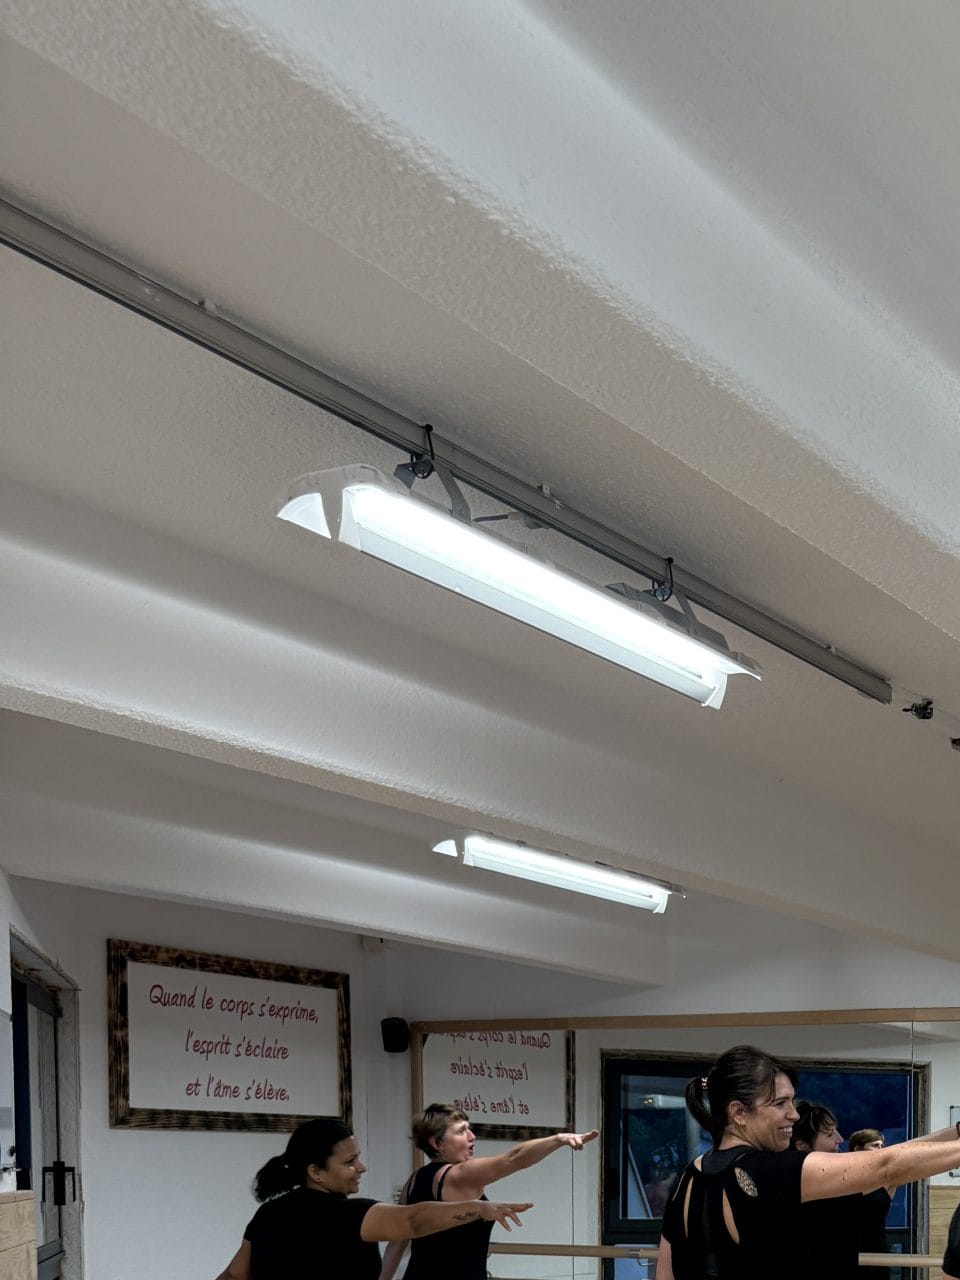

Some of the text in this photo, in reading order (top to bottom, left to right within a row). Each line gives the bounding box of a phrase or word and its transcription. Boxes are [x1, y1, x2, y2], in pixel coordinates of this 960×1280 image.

[149, 984, 197, 1009] Quand
[202, 986, 215, 1010] le
[220, 998, 255, 1021] corps
[186, 1029, 289, 1061] l'esprit s'éclaire
[186, 1076, 202, 1097] et
[206, 1074, 241, 1099] l'âme
